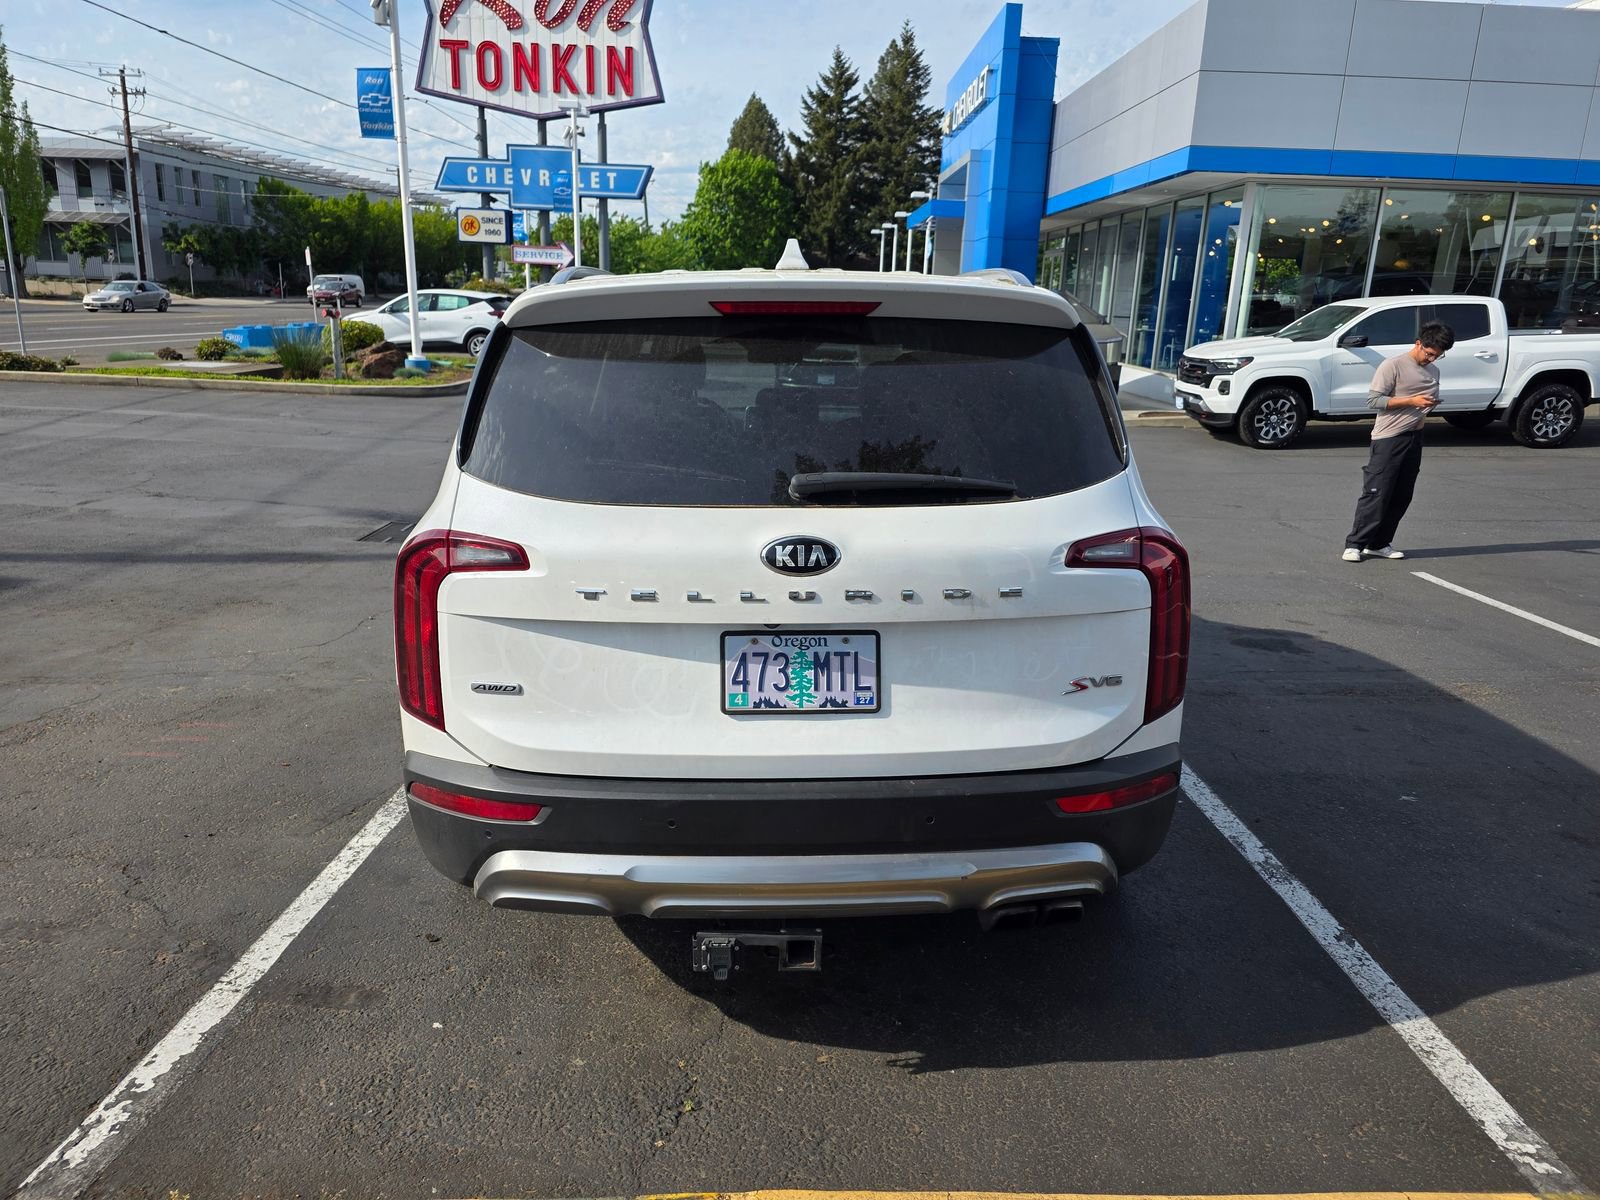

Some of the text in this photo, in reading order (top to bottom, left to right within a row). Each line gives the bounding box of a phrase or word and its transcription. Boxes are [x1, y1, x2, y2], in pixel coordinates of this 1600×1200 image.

[439, 39, 634, 96] TONKIN
[364, 76, 384, 84] Ron
[362, 121, 393, 130] Tonkin
[466, 166, 617, 189] CHEVRLET
[464, 219, 477, 232] OK
[481, 217, 504, 225] SINCE
[514, 250, 563, 260] SERVICE
[774, 546, 828, 568] KIA
[575, 586, 1023, 602] TELLURIDE
[771, 634, 829, 651] Oregon
[731, 651, 872, 693] 473 MTL
[474, 684, 516, 692] AWD
[734, 694, 743, 704] 4
[859, 696, 871, 704] 27
